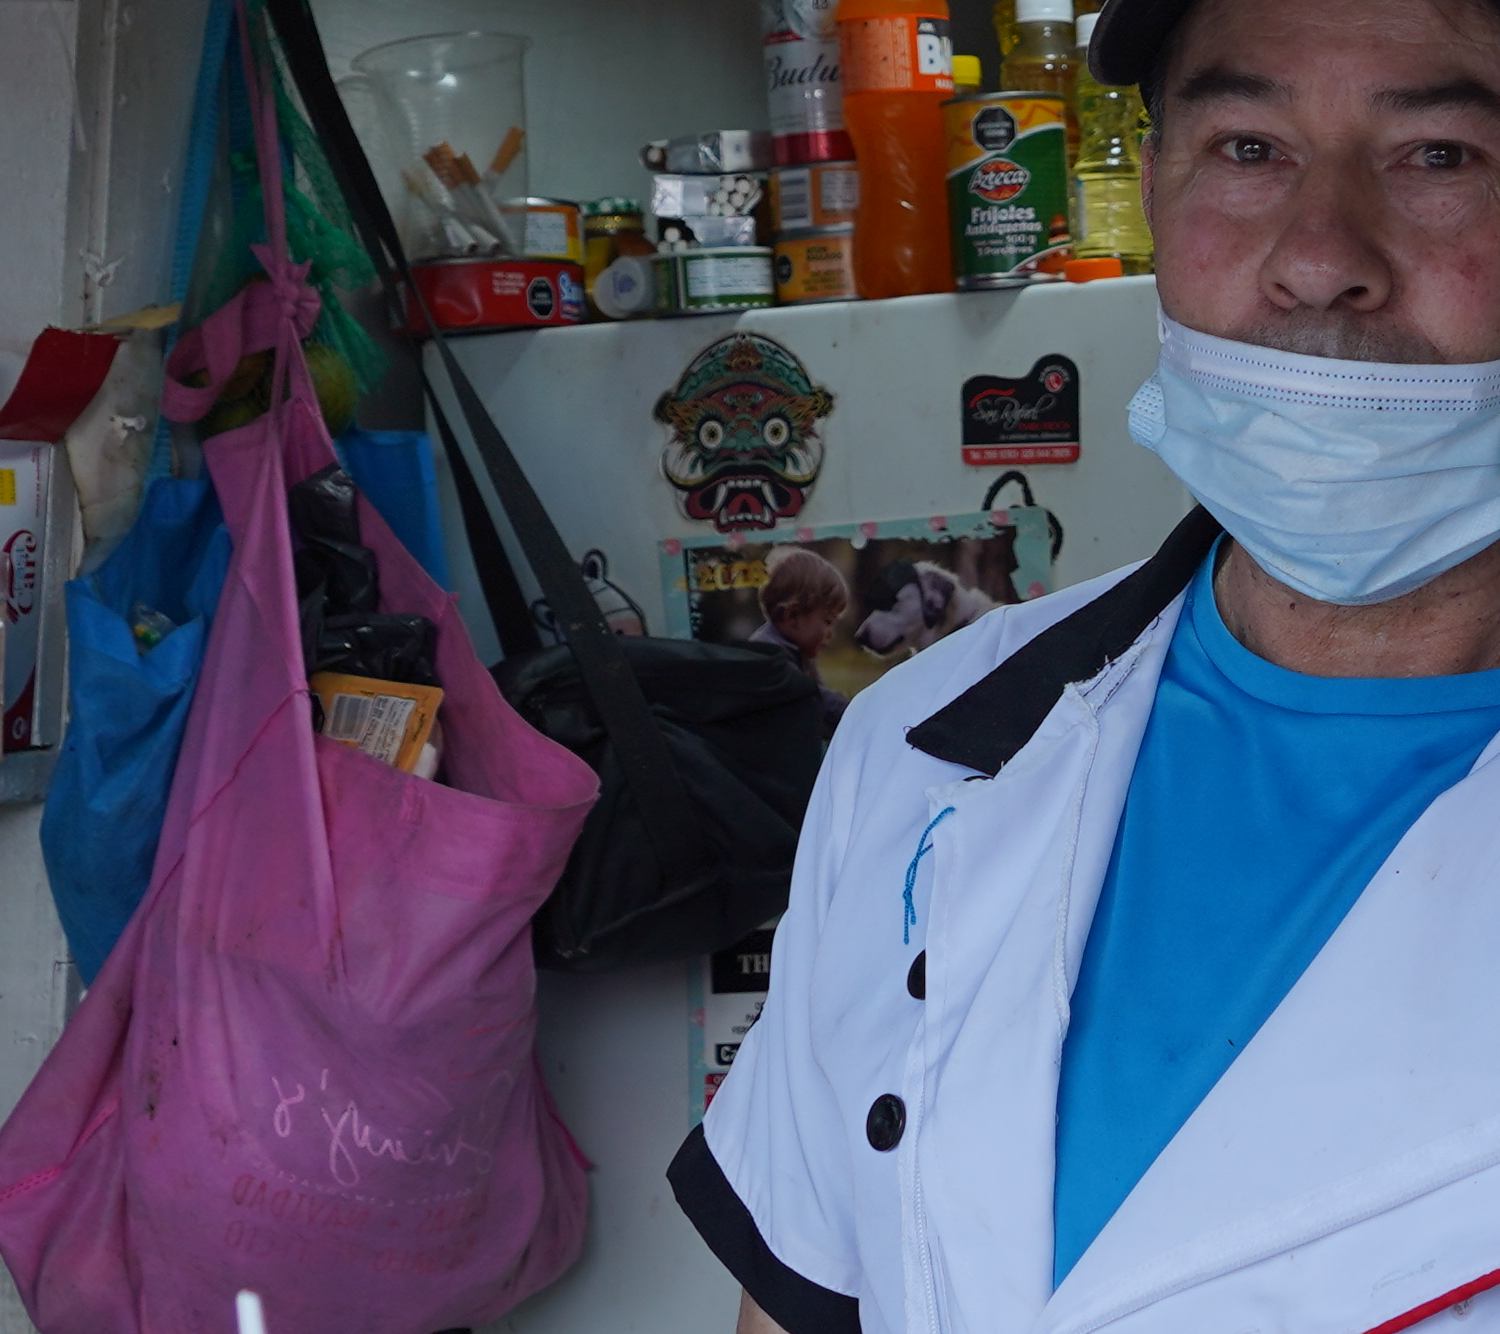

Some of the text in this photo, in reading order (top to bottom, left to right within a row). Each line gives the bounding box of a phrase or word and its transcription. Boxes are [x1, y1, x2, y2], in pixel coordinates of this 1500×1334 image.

[970, 169, 1028, 191] Azteca
[970, 204, 1036, 224] Frijoles
[17, 532, 36, 616] Care
